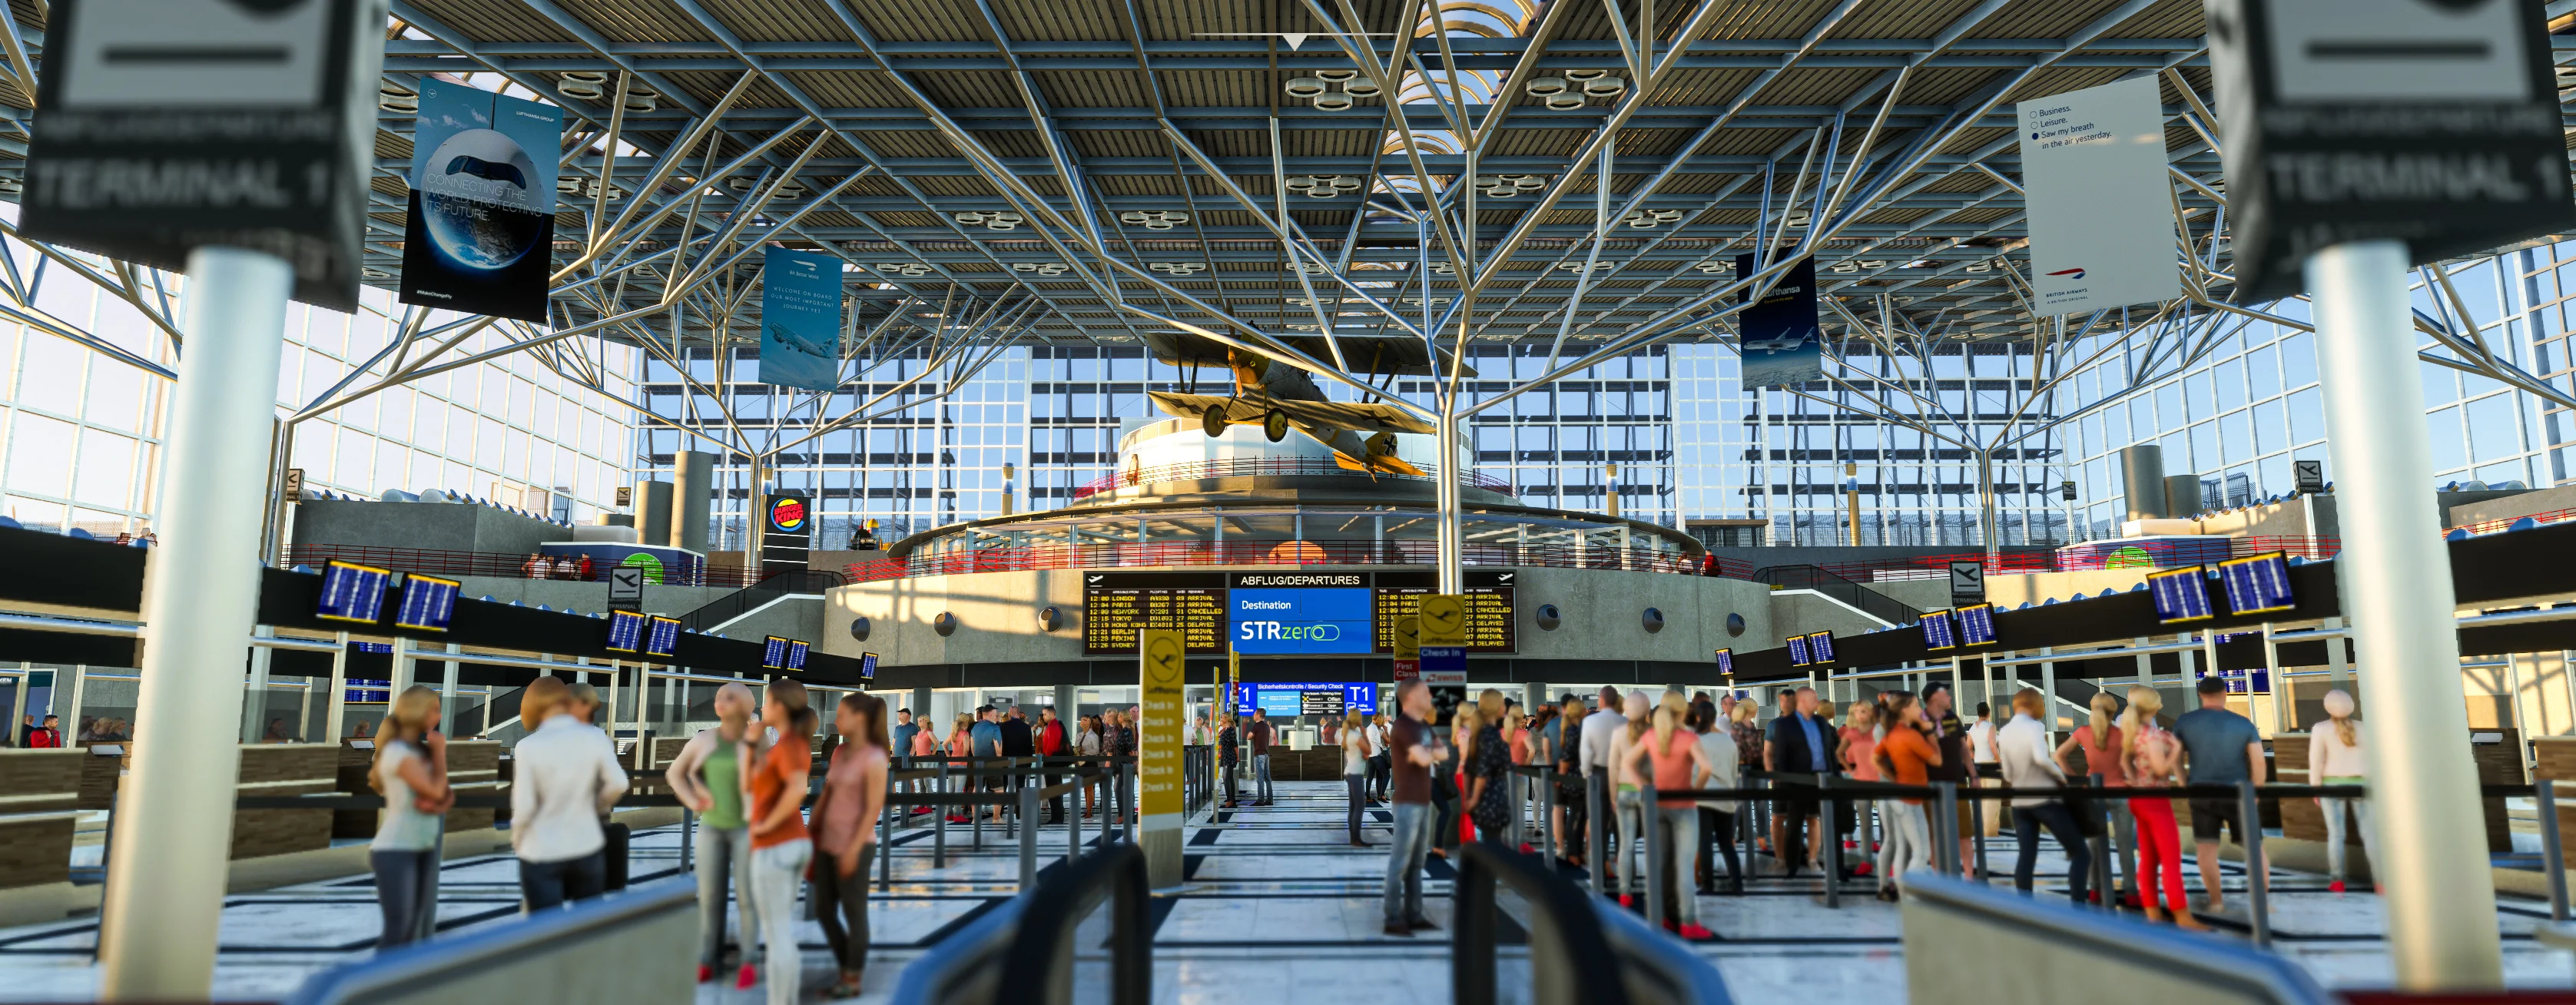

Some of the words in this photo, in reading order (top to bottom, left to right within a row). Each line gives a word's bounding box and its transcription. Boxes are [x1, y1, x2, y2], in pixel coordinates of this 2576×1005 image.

[516, 111, 539, 119] LUFTHANSA
[2039, 106, 2071, 117] Business.
[2041, 117, 2067, 128] Leisure.
[2071, 122, 2094, 133] breath
[2075, 131, 2112, 144] yesterday.
[35, 158, 290, 209] TERMINAL
[304, 159, 328, 207] 1
[2269, 154, 2530, 201] TERMINAL
[2537, 154, 2564, 201] 1
[427, 173, 502, 196] CONNECTING
[505, 187, 527, 201] THE
[426, 187, 470, 204] WORLD.
[473, 195, 542, 217] PROTECTING
[424, 200, 441, 212] ITS
[444, 204, 490, 221] FUTURE.
[774, 286, 800, 295] WELCOME
[803, 299, 834, 308] IMPORTANT
[774, 504, 803, 515] BURGER
[775, 510, 804, 524] KING
[1241, 576, 1359, 585] ABFLUG/DEPARTURES
[1242, 600, 1291, 609] Destination
[1241, 621, 1325, 640] STRzero
[1349, 687, 1368, 701] T1
